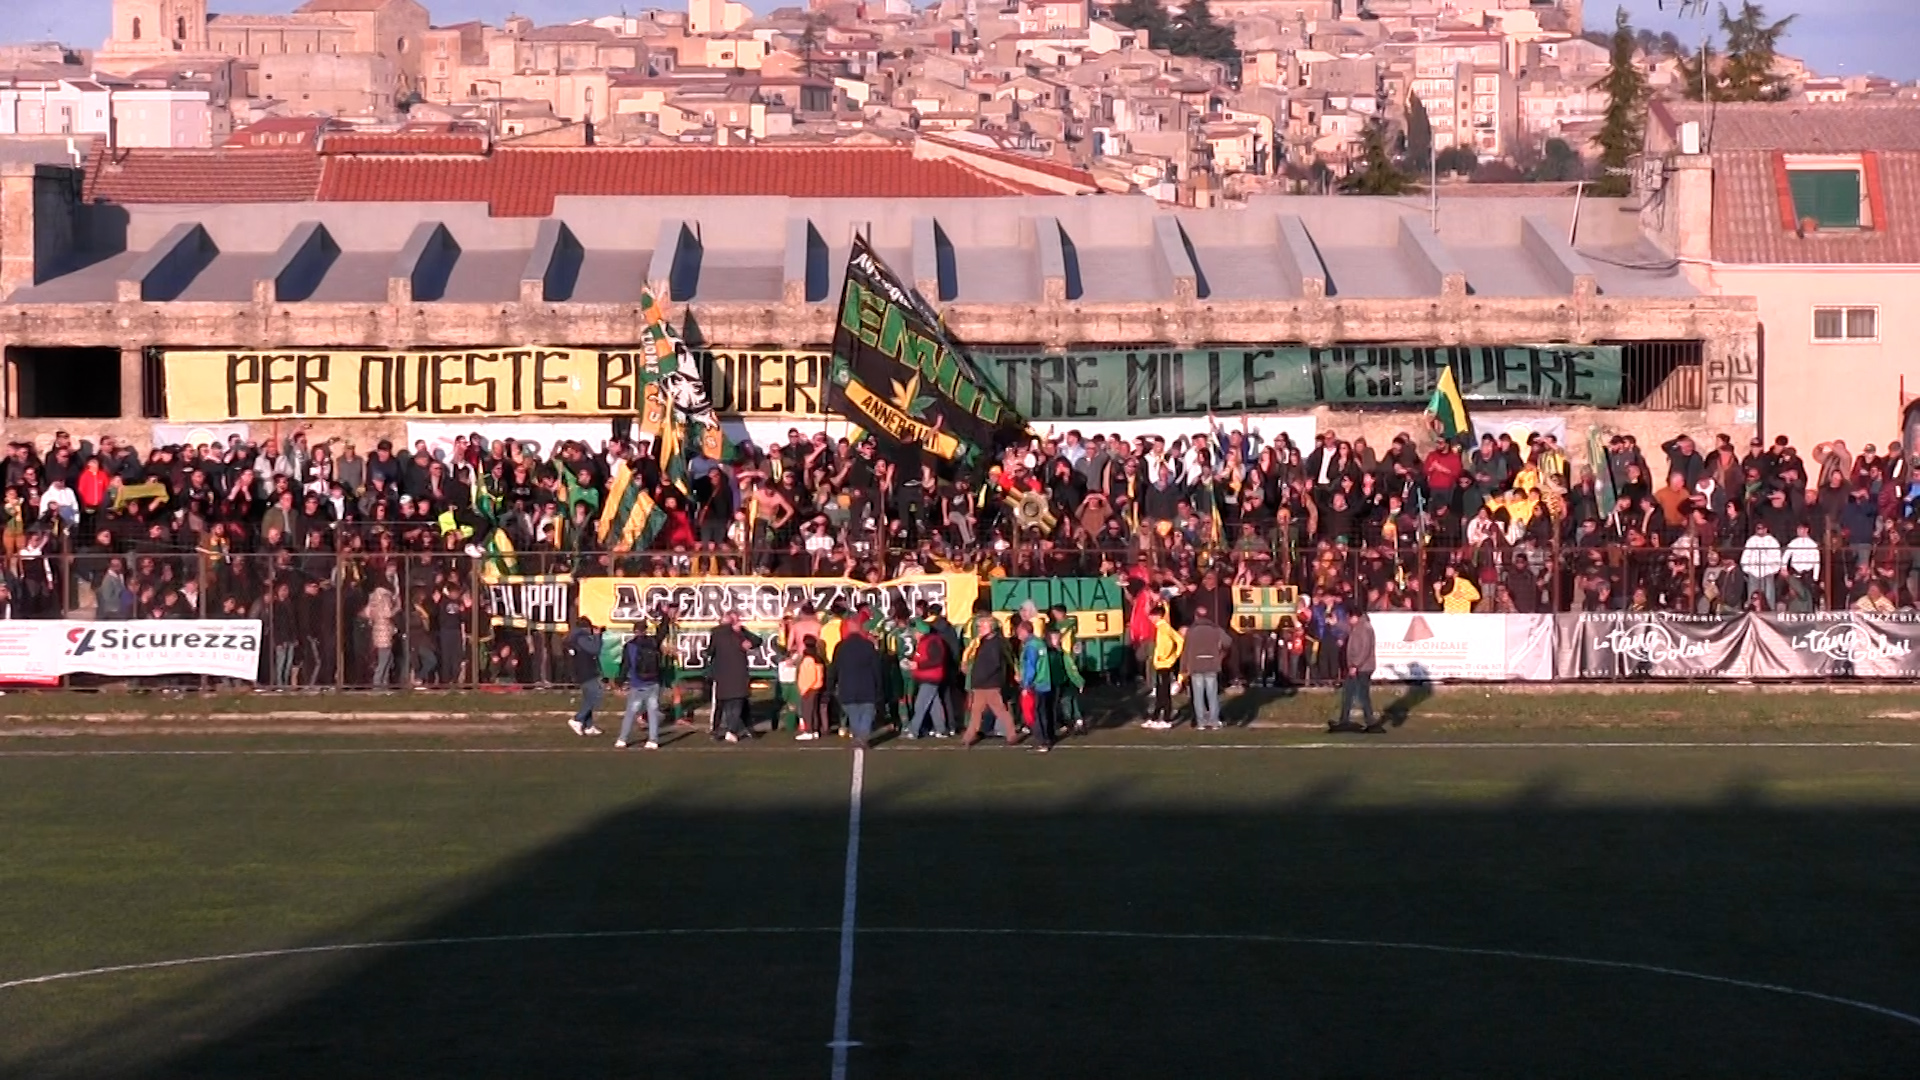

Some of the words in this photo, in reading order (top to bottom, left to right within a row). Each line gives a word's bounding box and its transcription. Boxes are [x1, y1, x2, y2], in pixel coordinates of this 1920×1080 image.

[226, 354, 330, 417] PER
[599, 353, 831, 413] BDIER
[996, 357, 1098, 417] TRE
[1126, 350, 1277, 417] MILLE
[489, 583, 567, 622] FILIPPO
[998, 579, 1111, 611] ZONA
[1579, 612, 1658, 622] RISTORANTE
[1777, 612, 1855, 622] RISTORANTE
[101, 628, 257, 651] Sicurezza
